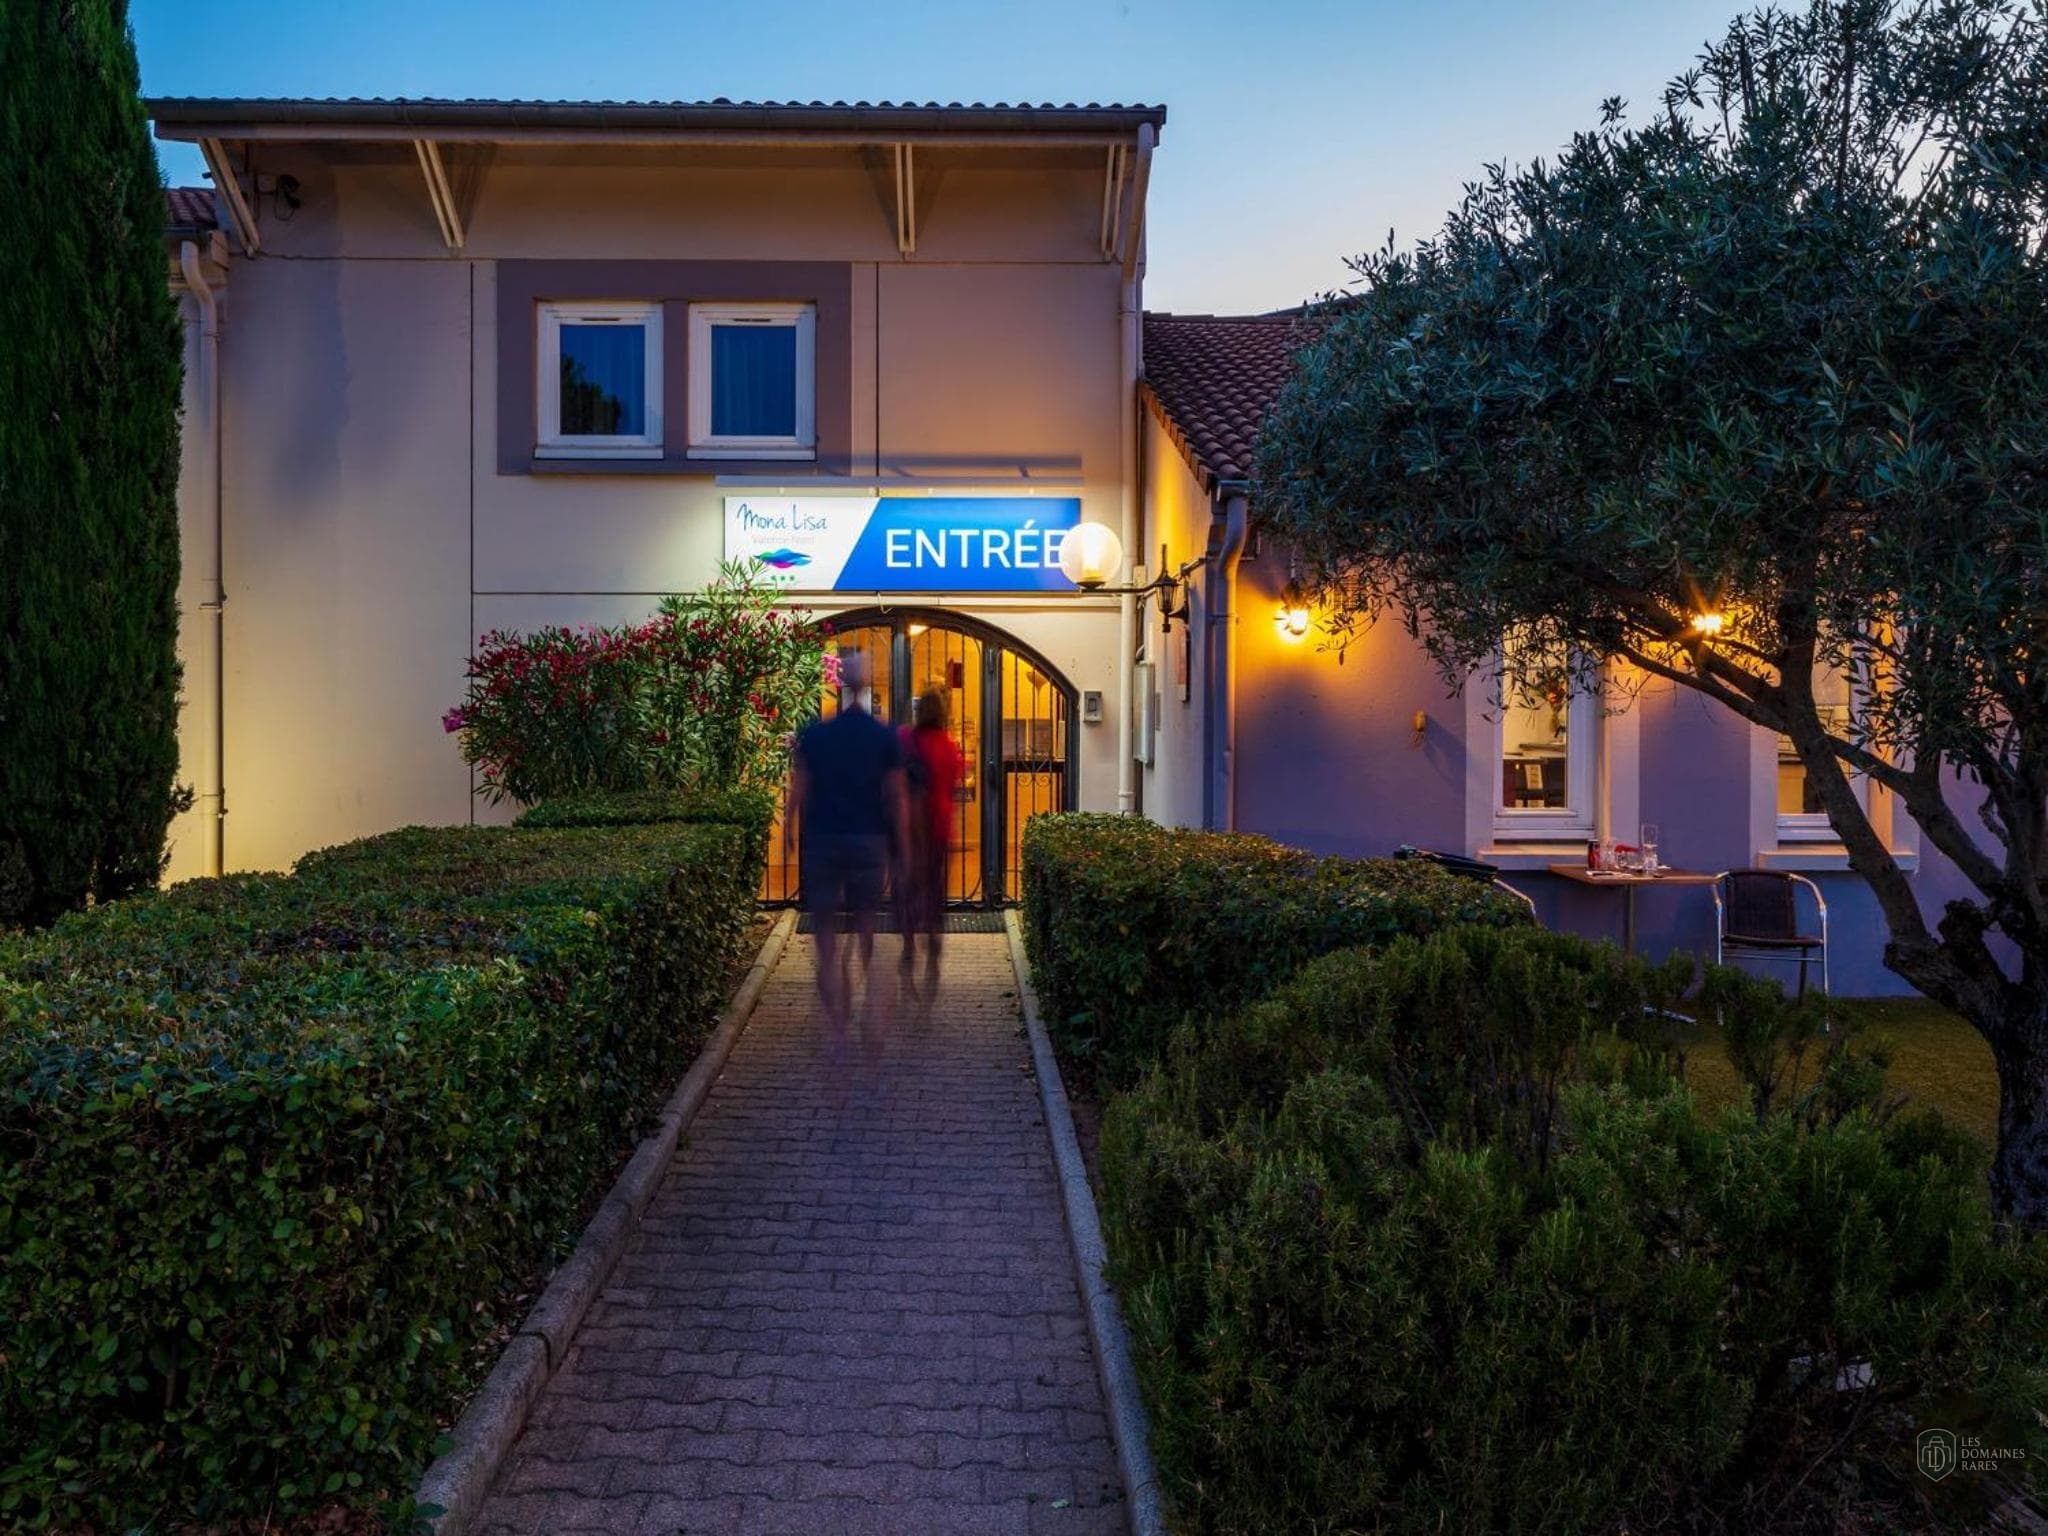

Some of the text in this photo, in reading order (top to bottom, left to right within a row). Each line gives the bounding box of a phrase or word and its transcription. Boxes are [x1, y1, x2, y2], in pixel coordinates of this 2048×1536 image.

[737, 503, 828, 531] Mona Lisa
[886, 519, 1069, 568] ENTRÉE
